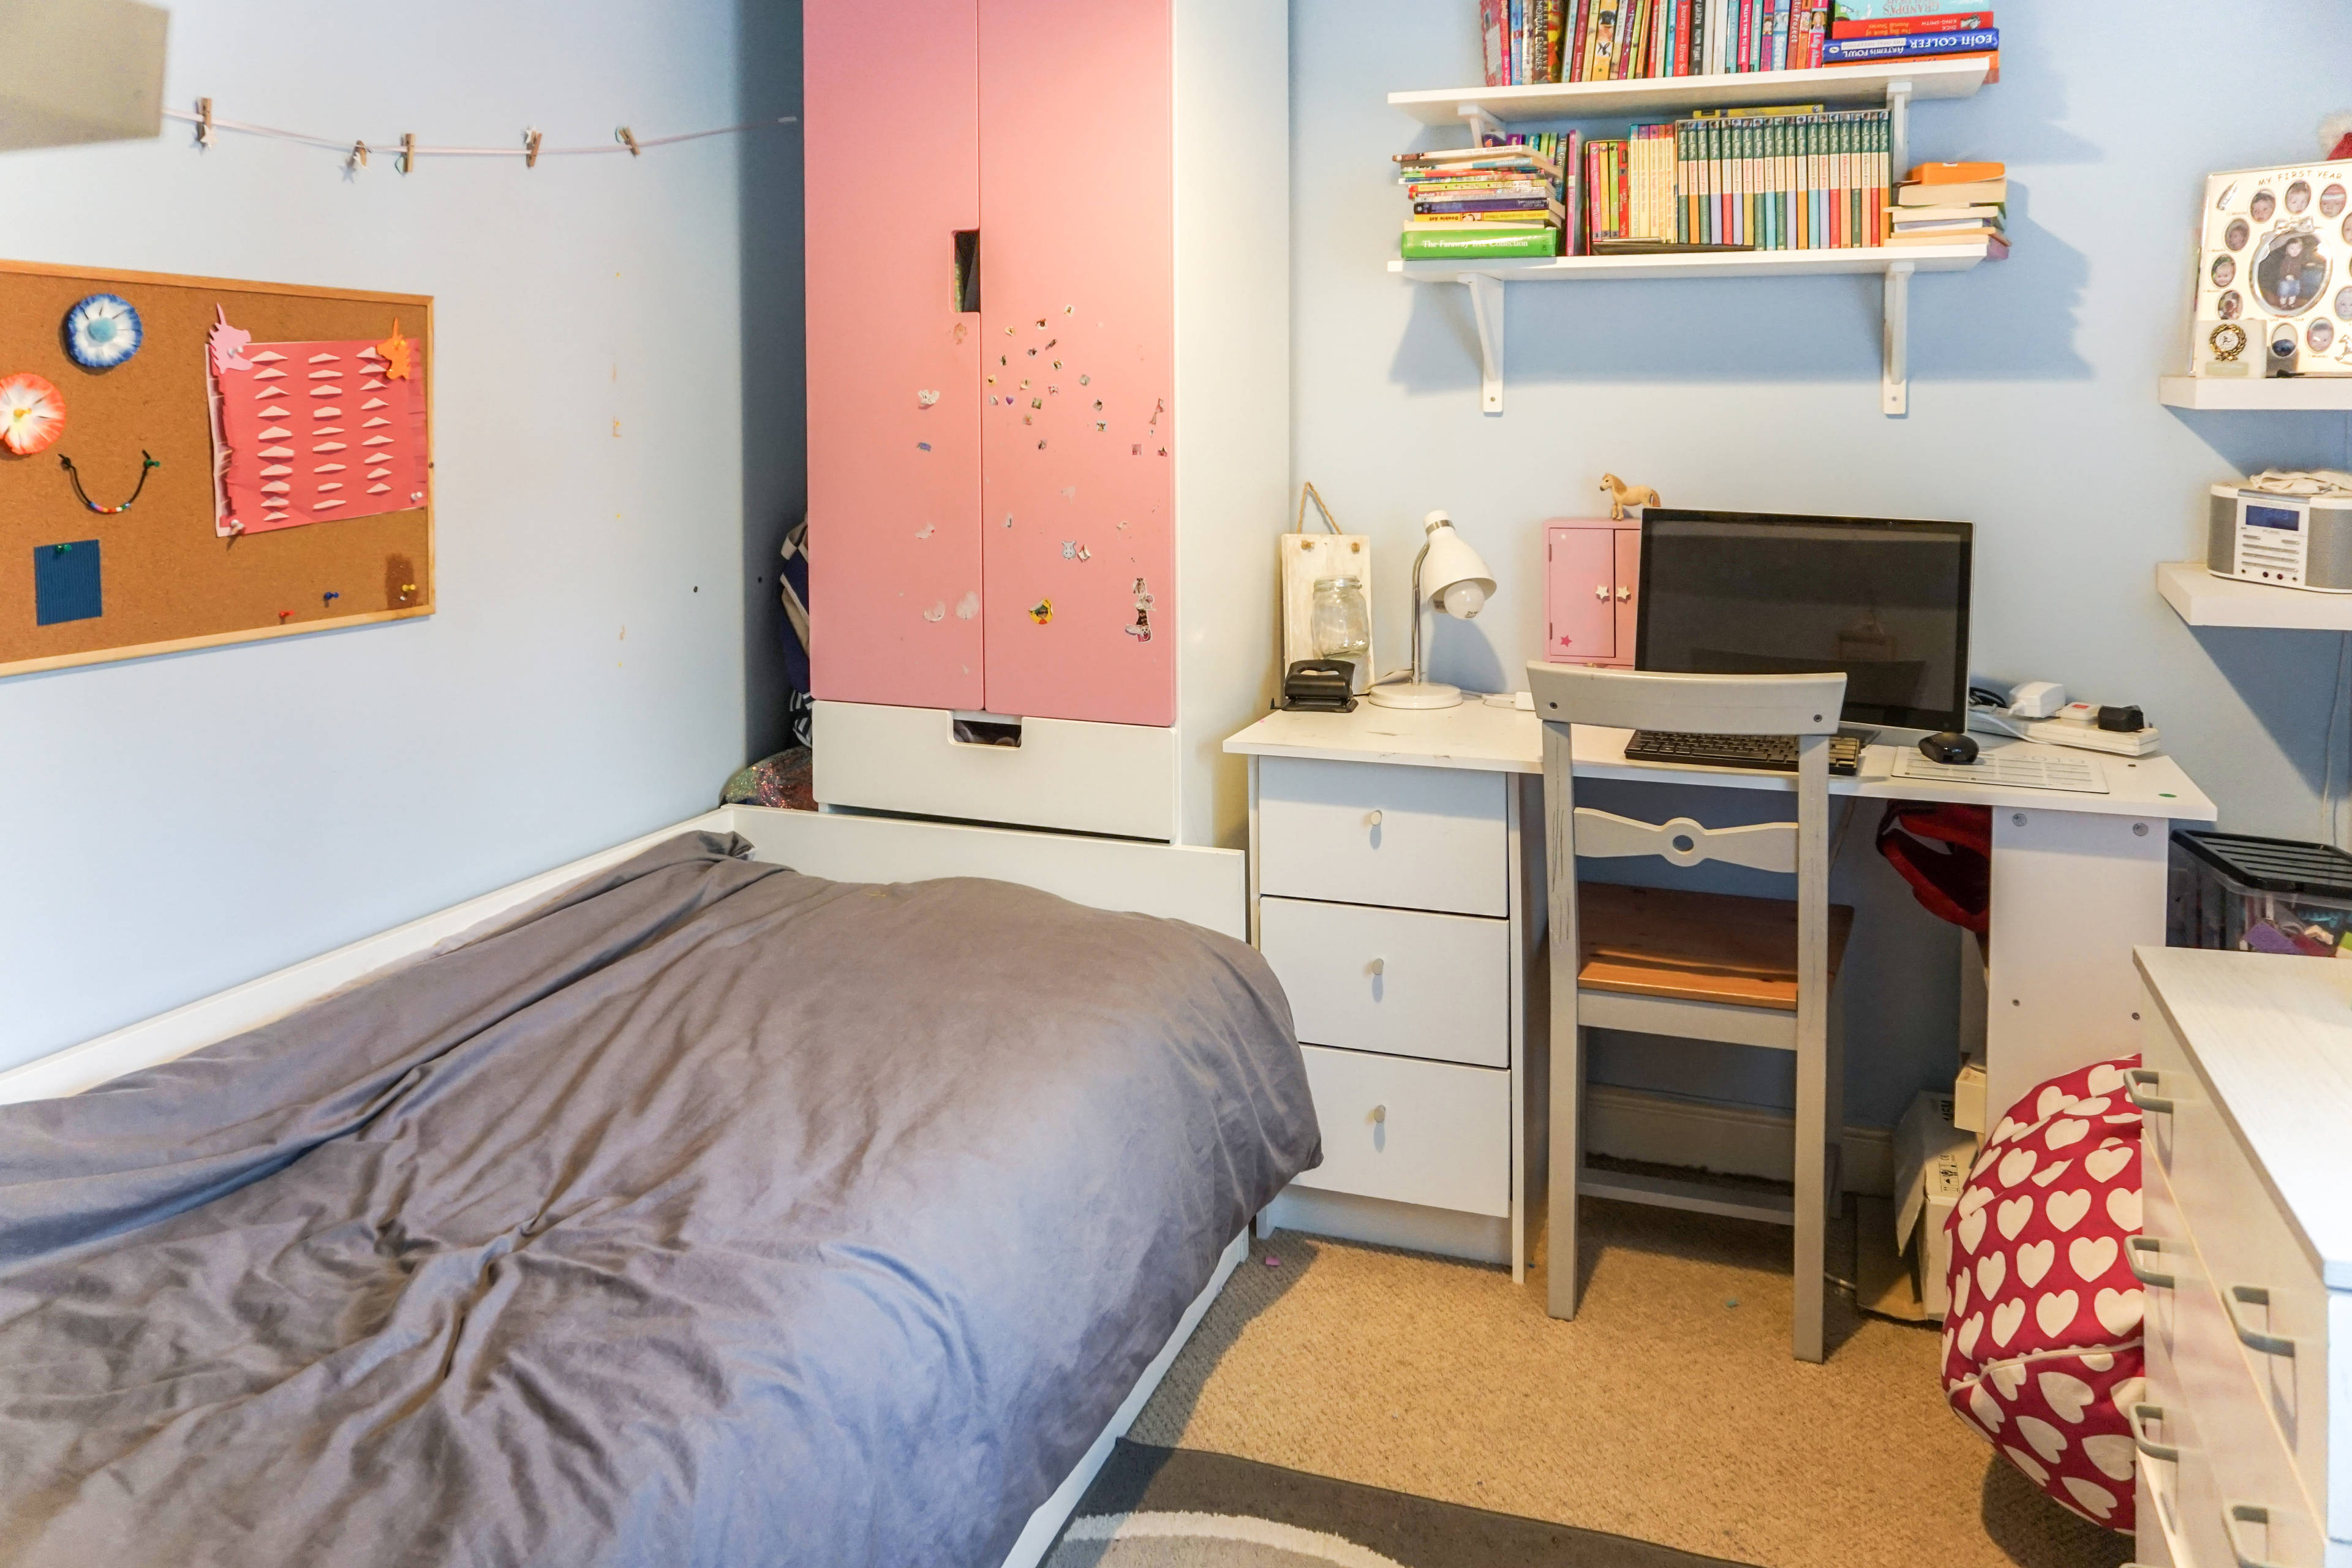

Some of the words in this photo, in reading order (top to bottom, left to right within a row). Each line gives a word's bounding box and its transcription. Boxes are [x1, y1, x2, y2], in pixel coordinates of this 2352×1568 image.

[1534, 1, 1544, 35] MORTAL
[1679, 4, 1689, 31] Journey
[1790, 14, 1800, 43] Project
[1909, 36, 1958, 49] COLFER
[1535, 36, 1544, 70] ENGINES
[1842, 49, 1869, 58] FOWL
[2258, 176, 2272, 186] MY
[2278, 170, 2312, 182] FIRST
[2317, 171, 2343, 179] YEAR
[1439, 240, 1469, 249] Faraway
[2017, 755, 2086, 764] 2019
